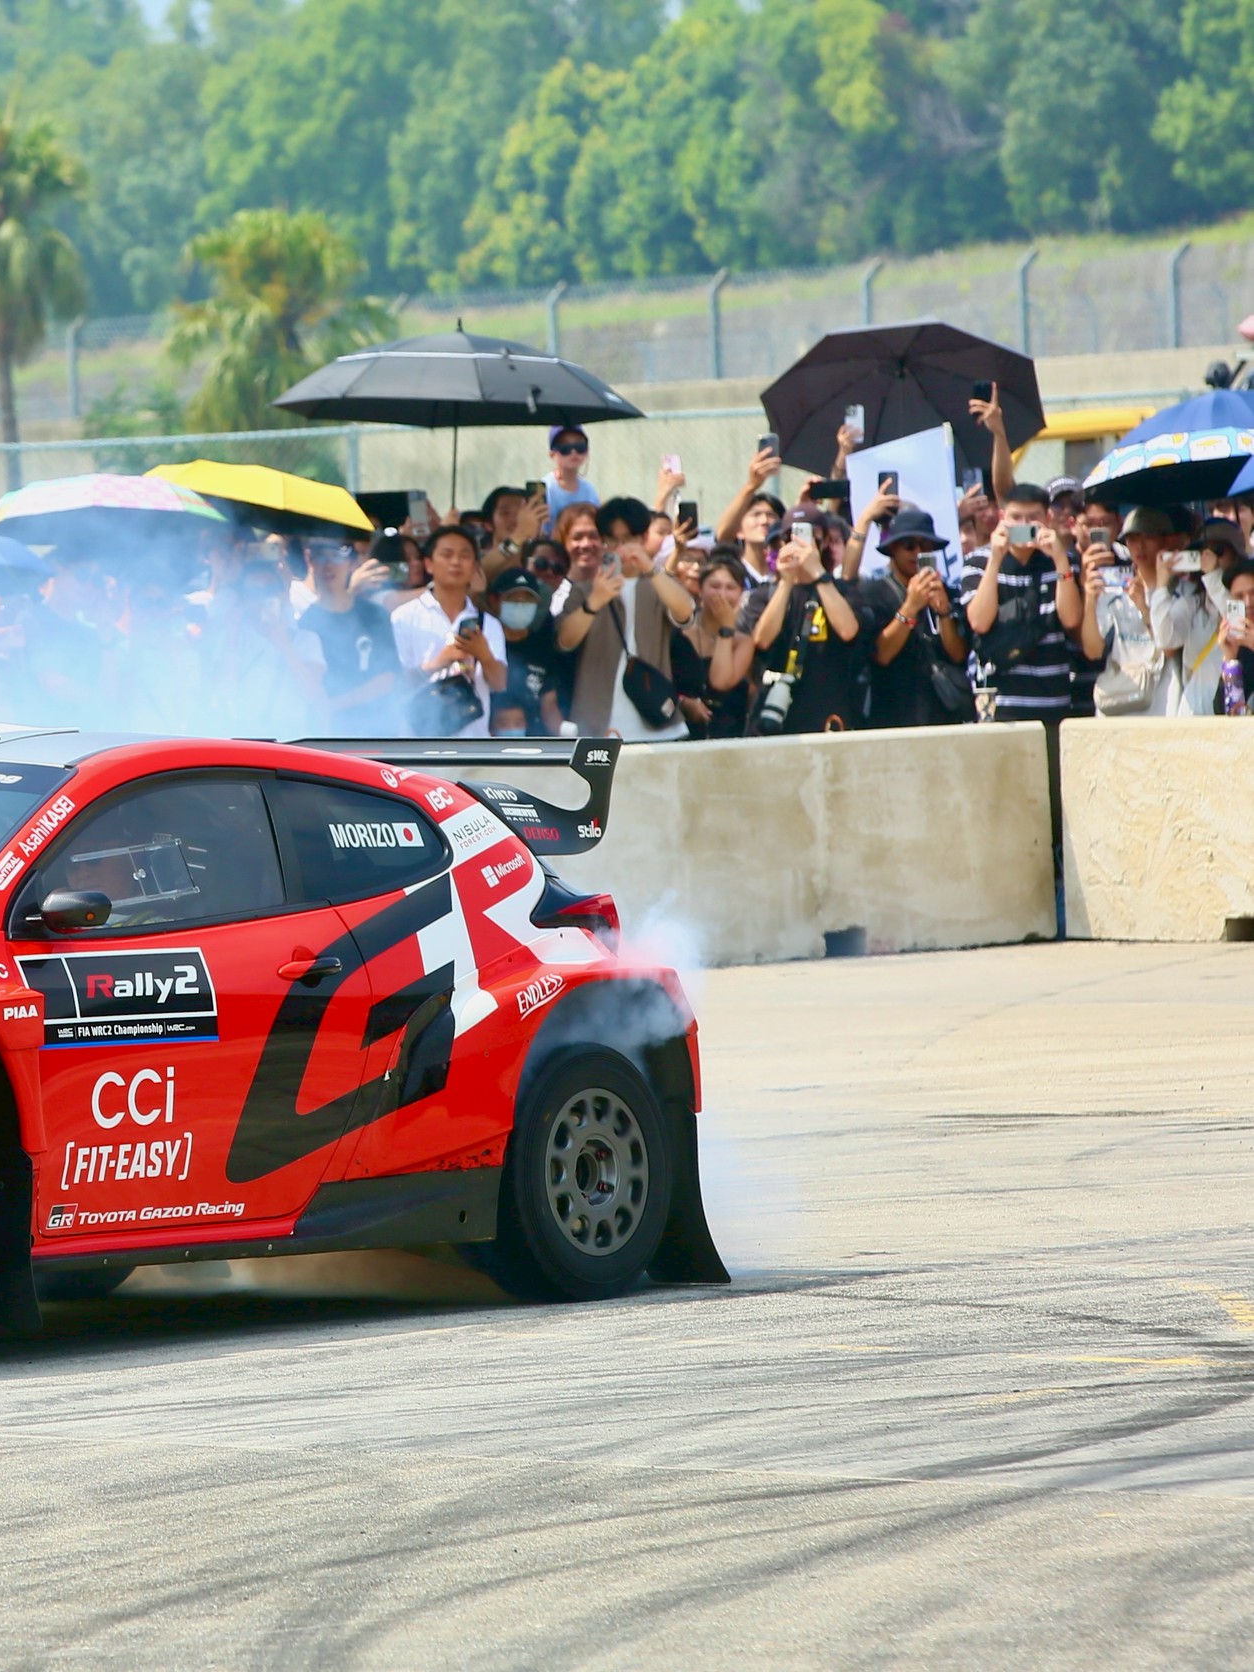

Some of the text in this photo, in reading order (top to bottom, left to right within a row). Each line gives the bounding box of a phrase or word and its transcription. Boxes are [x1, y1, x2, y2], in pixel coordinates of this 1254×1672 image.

[482, 787, 519, 802] KINTO
[17, 794, 76, 858] AsahiKASEI
[328, 823, 397, 849] MORIZO
[452, 815, 493, 842] NISULA
[521, 826, 562, 841] DENSO
[577, 820, 602, 839] Stilo
[493, 852, 526, 878] Microsoft
[86, 965, 200, 1004] Rally2
[516, 973, 563, 1014] ENDLESS
[3, 1004, 38, 1021] PIAA
[77, 1026, 90, 1038] FIA
[91, 1024, 112, 1036] WRC2
[113, 1022, 163, 1037] Championship
[47, 1201, 245, 1228] GR TOYOTA GAZOO Racing
